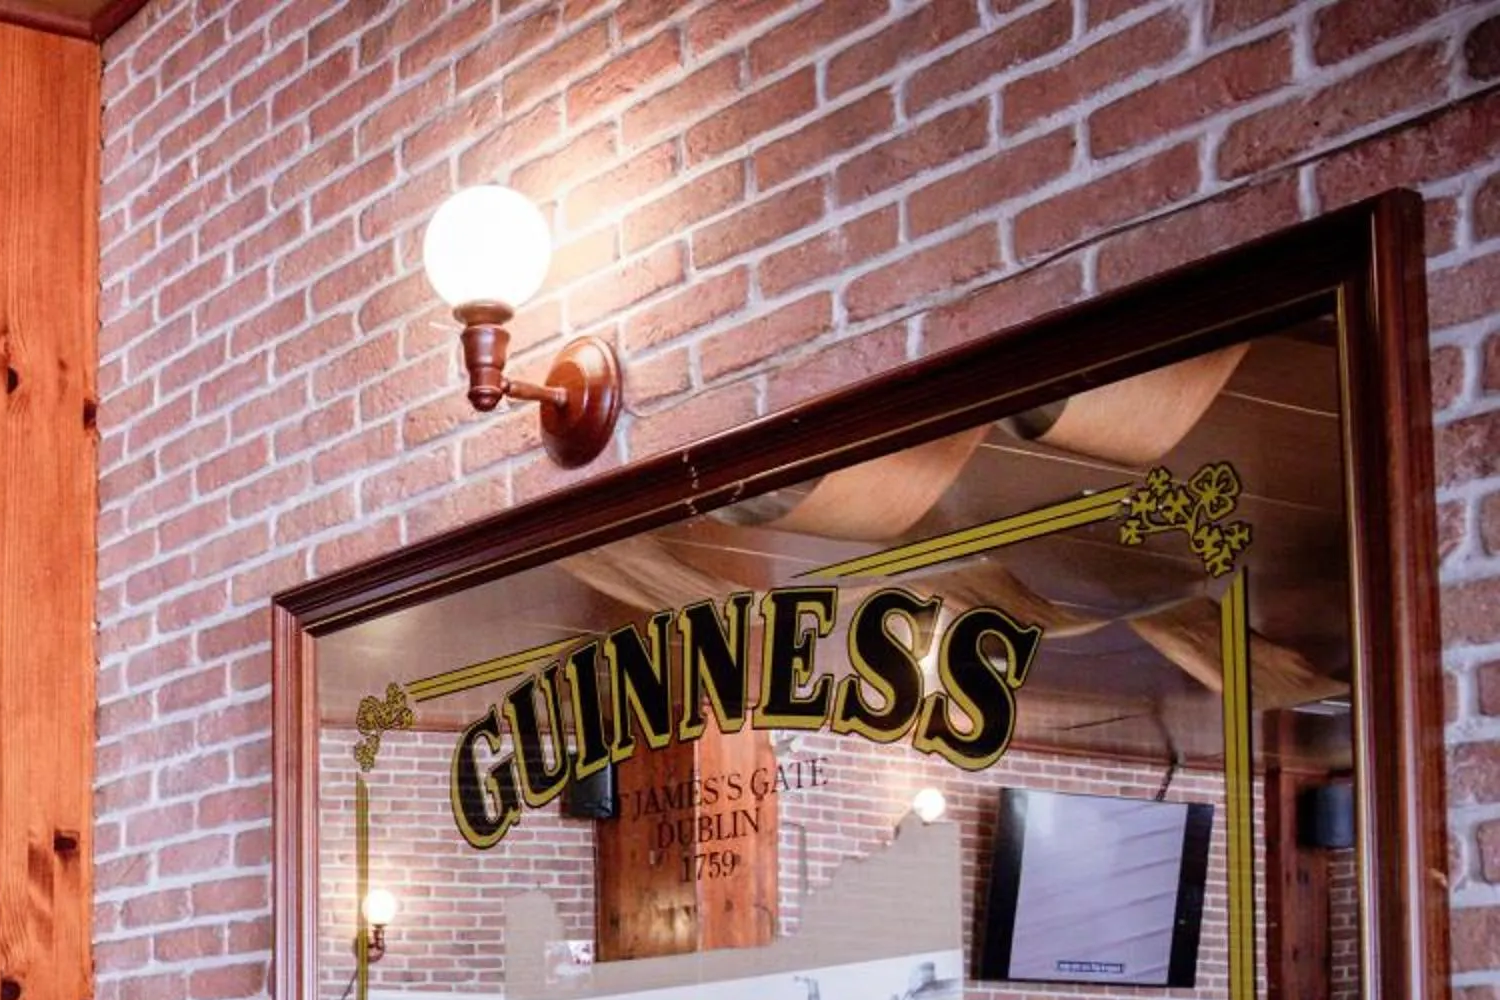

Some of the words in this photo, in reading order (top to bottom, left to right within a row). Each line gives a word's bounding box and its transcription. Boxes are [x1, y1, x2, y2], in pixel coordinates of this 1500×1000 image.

[451, 584, 1043, 850] GUINNESS
[633, 773, 742, 821] JAMES'S
[750, 757, 828, 799] GATE
[659, 808, 759, 848] DUBLIN
[681, 850, 736, 883] 1759
